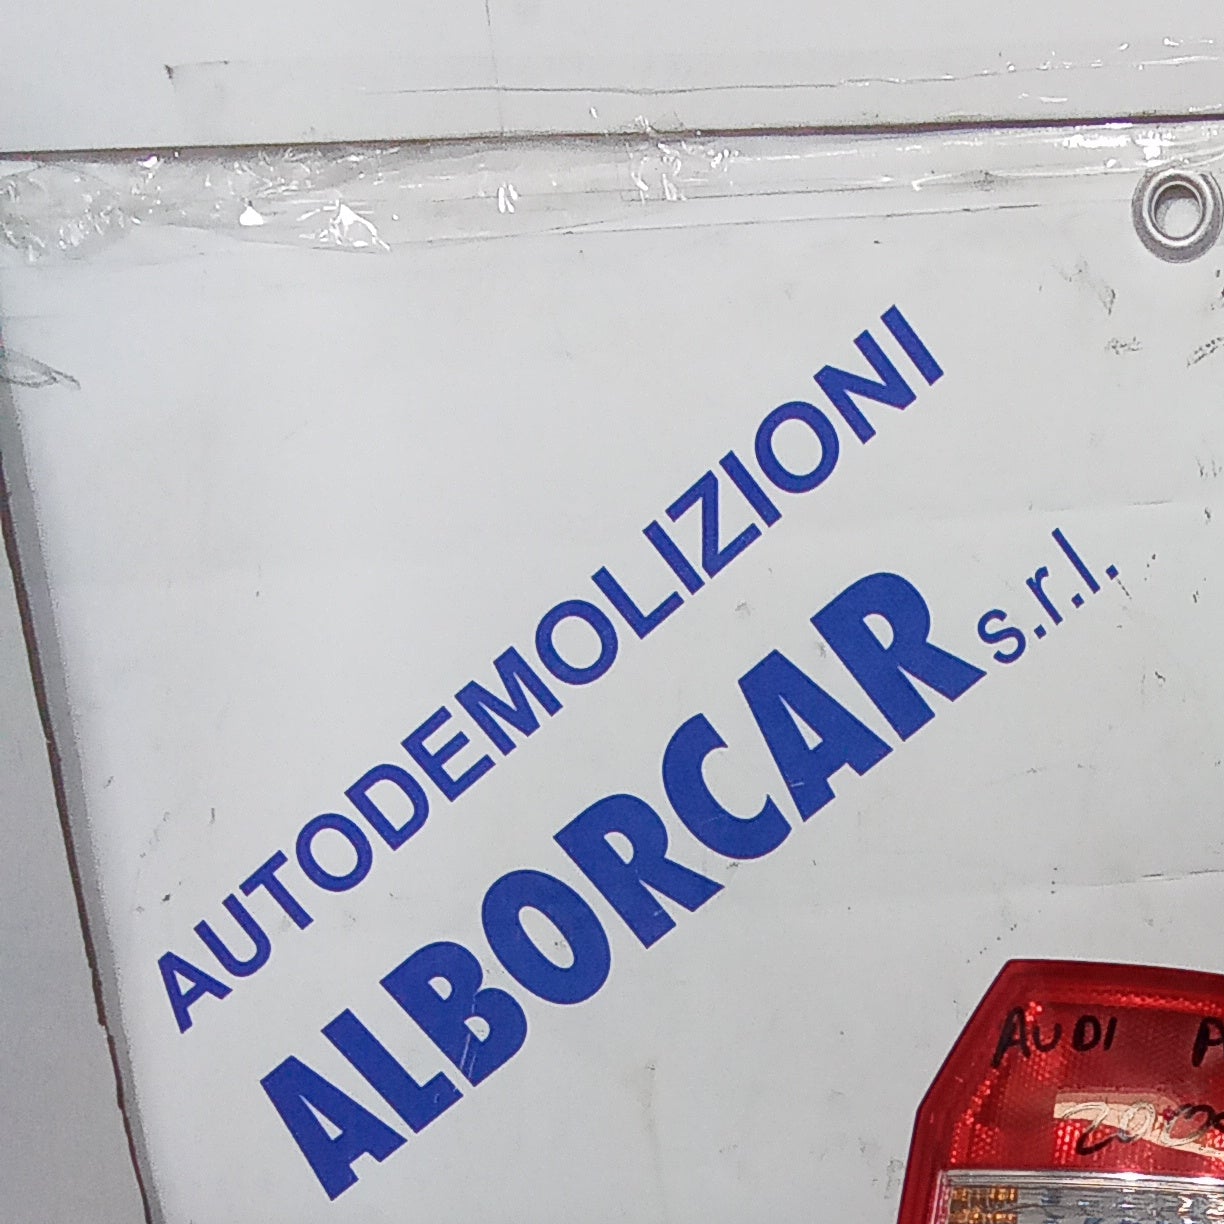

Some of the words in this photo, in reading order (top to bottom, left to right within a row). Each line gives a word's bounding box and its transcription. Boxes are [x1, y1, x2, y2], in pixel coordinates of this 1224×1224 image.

[158, 306, 944, 1031] AUTODEMOLIZIONI
[260, 572, 986, 1200] ALBORCAR
[977, 528, 1119, 663] s.r.l.
[992, 1006, 1117, 1067] AUDI
